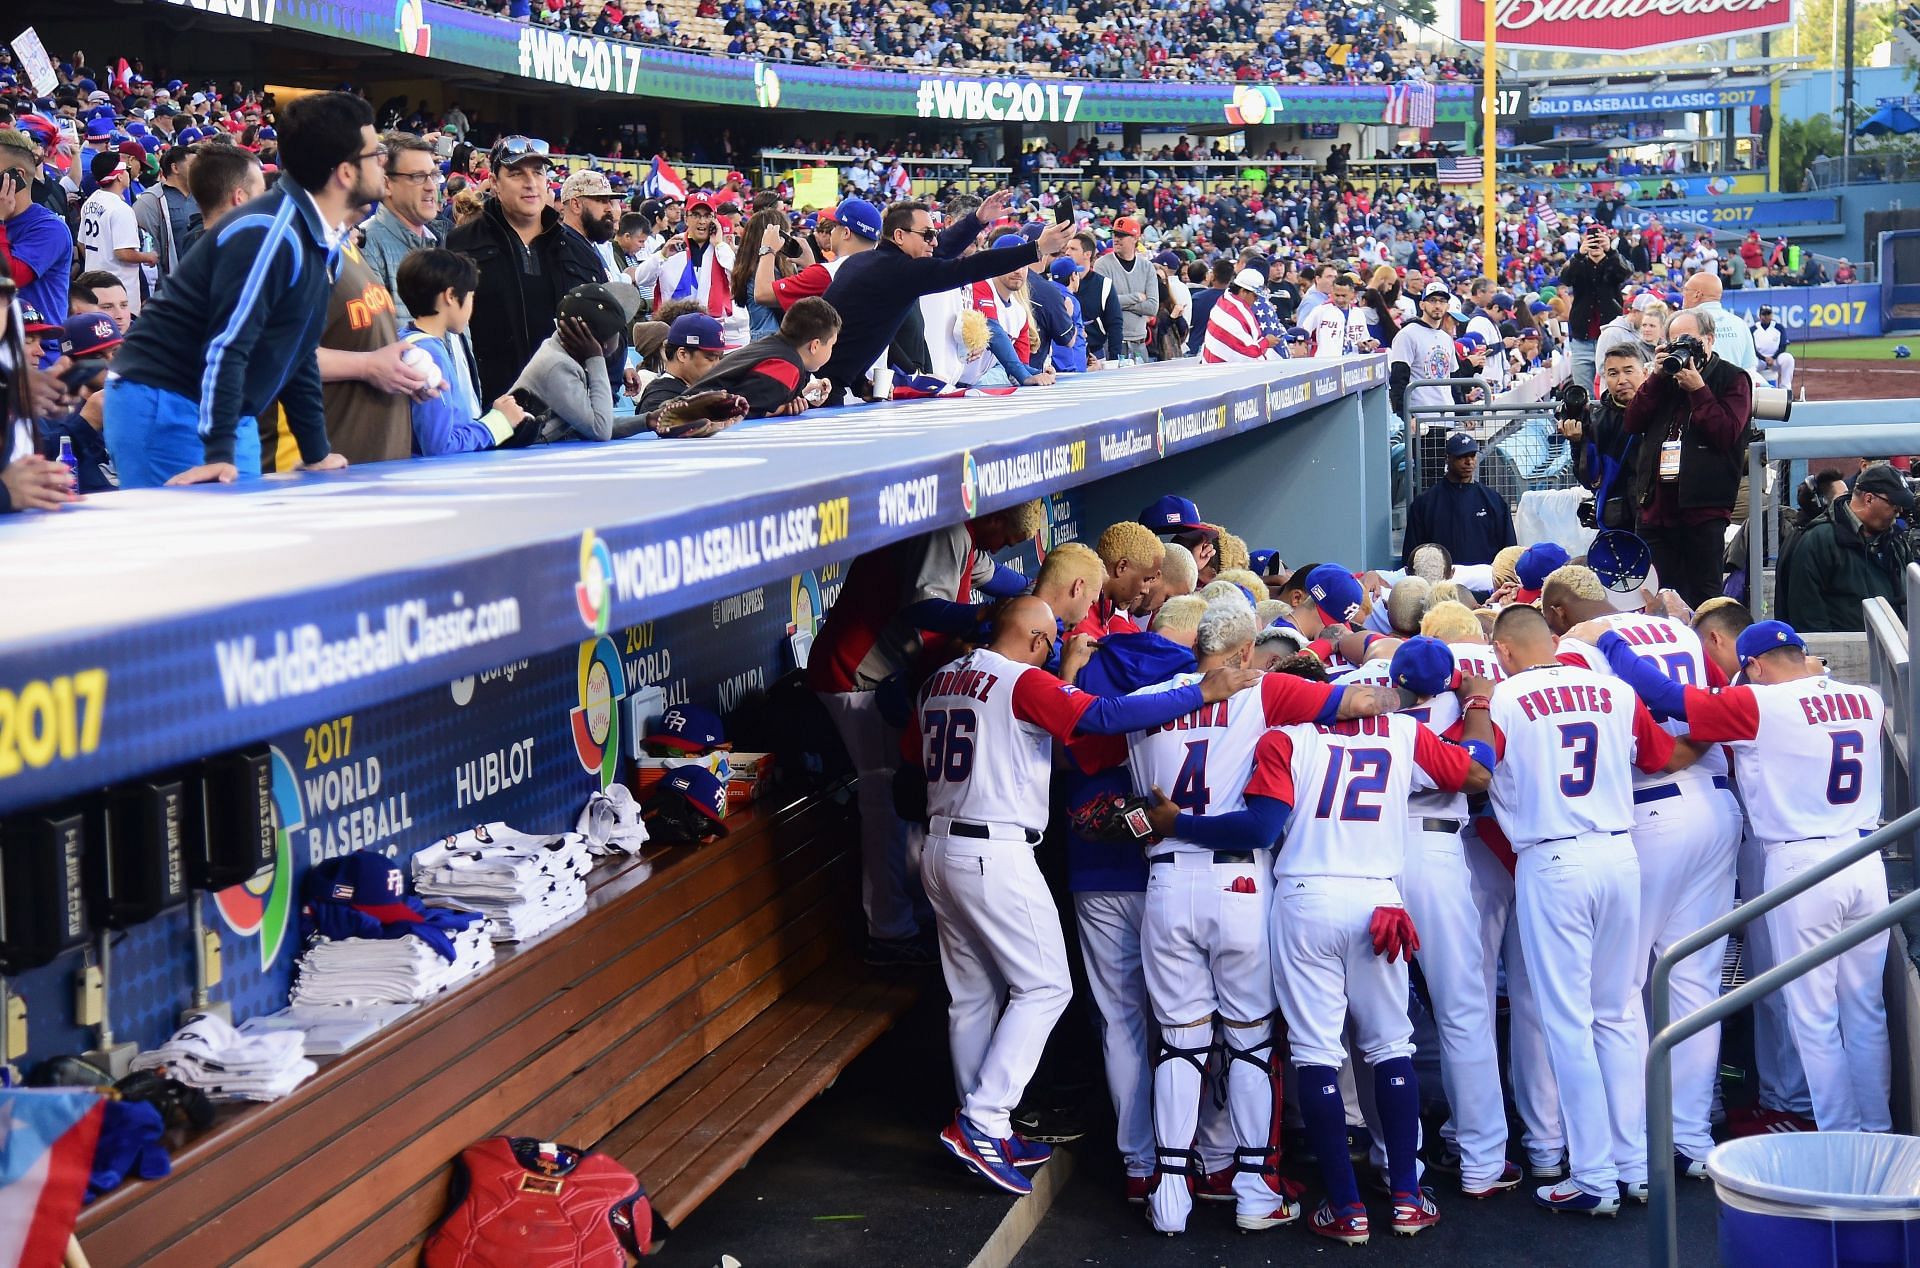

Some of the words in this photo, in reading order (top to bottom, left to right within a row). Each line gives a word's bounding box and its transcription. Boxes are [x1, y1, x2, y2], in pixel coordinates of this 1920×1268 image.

[518, 27, 642, 95] #WBC2017
[916, 79, 1084, 123] #WBC2017
[1530, 98, 1570, 114] ORLD
[1572, 96, 1649, 113] BASEBALL
[1651, 92, 1716, 108] CLASSIC
[1718, 90, 1756, 105] 2017
[1712, 206, 1755, 223] 2017
[1809, 301, 1868, 328] 2017
[976, 461, 1008, 497] WORLD
[1007, 451, 1043, 489] BASEBALL
[1042, 445, 1071, 482] CLASSIC
[1070, 440, 1086, 473] 2017
[1099, 428, 1152, 464] WorldBaseballClassic.com
[879, 474, 939, 528] #WBC2017
[1053, 500, 1071, 522] WORLD
[612, 539, 680, 603] WORLD
[680, 519, 762, 587] BASEBALL
[760, 504, 819, 562] CLASSIC
[818, 496, 849, 546] 2017
[1054, 520, 1078, 546] BASEBALL
[721, 594, 742, 624] NIPPON
[741, 588, 764, 620] EXPRESS
[215, 590, 521, 710] WorldBaseballClassic.com
[626, 621, 654, 655] 2017
[625, 648, 671, 692] WORLD
[660, 677, 690, 714] BALL
[718, 665, 766, 716] NOMURA
[1516, 685, 1613, 722] FUENTES
[1798, 693, 1874, 725] ESPADA
[304, 715, 353, 770] 2017
[923, 708, 977, 783] 36
[1557, 721, 1599, 798] 3
[1825, 729, 1865, 806] 6
[304, 756, 382, 818] WORLD
[456, 737, 535, 809] HUBLOT
[1170, 738, 1211, 817] 4
[1315, 743, 1393, 822] 12
[258, 764, 272, 859] TELEPHONE
[308, 791, 413, 868] BASEBALL
[166, 794, 182, 895] TELEPHONE
[65, 829, 81, 937] TELEPHONE
